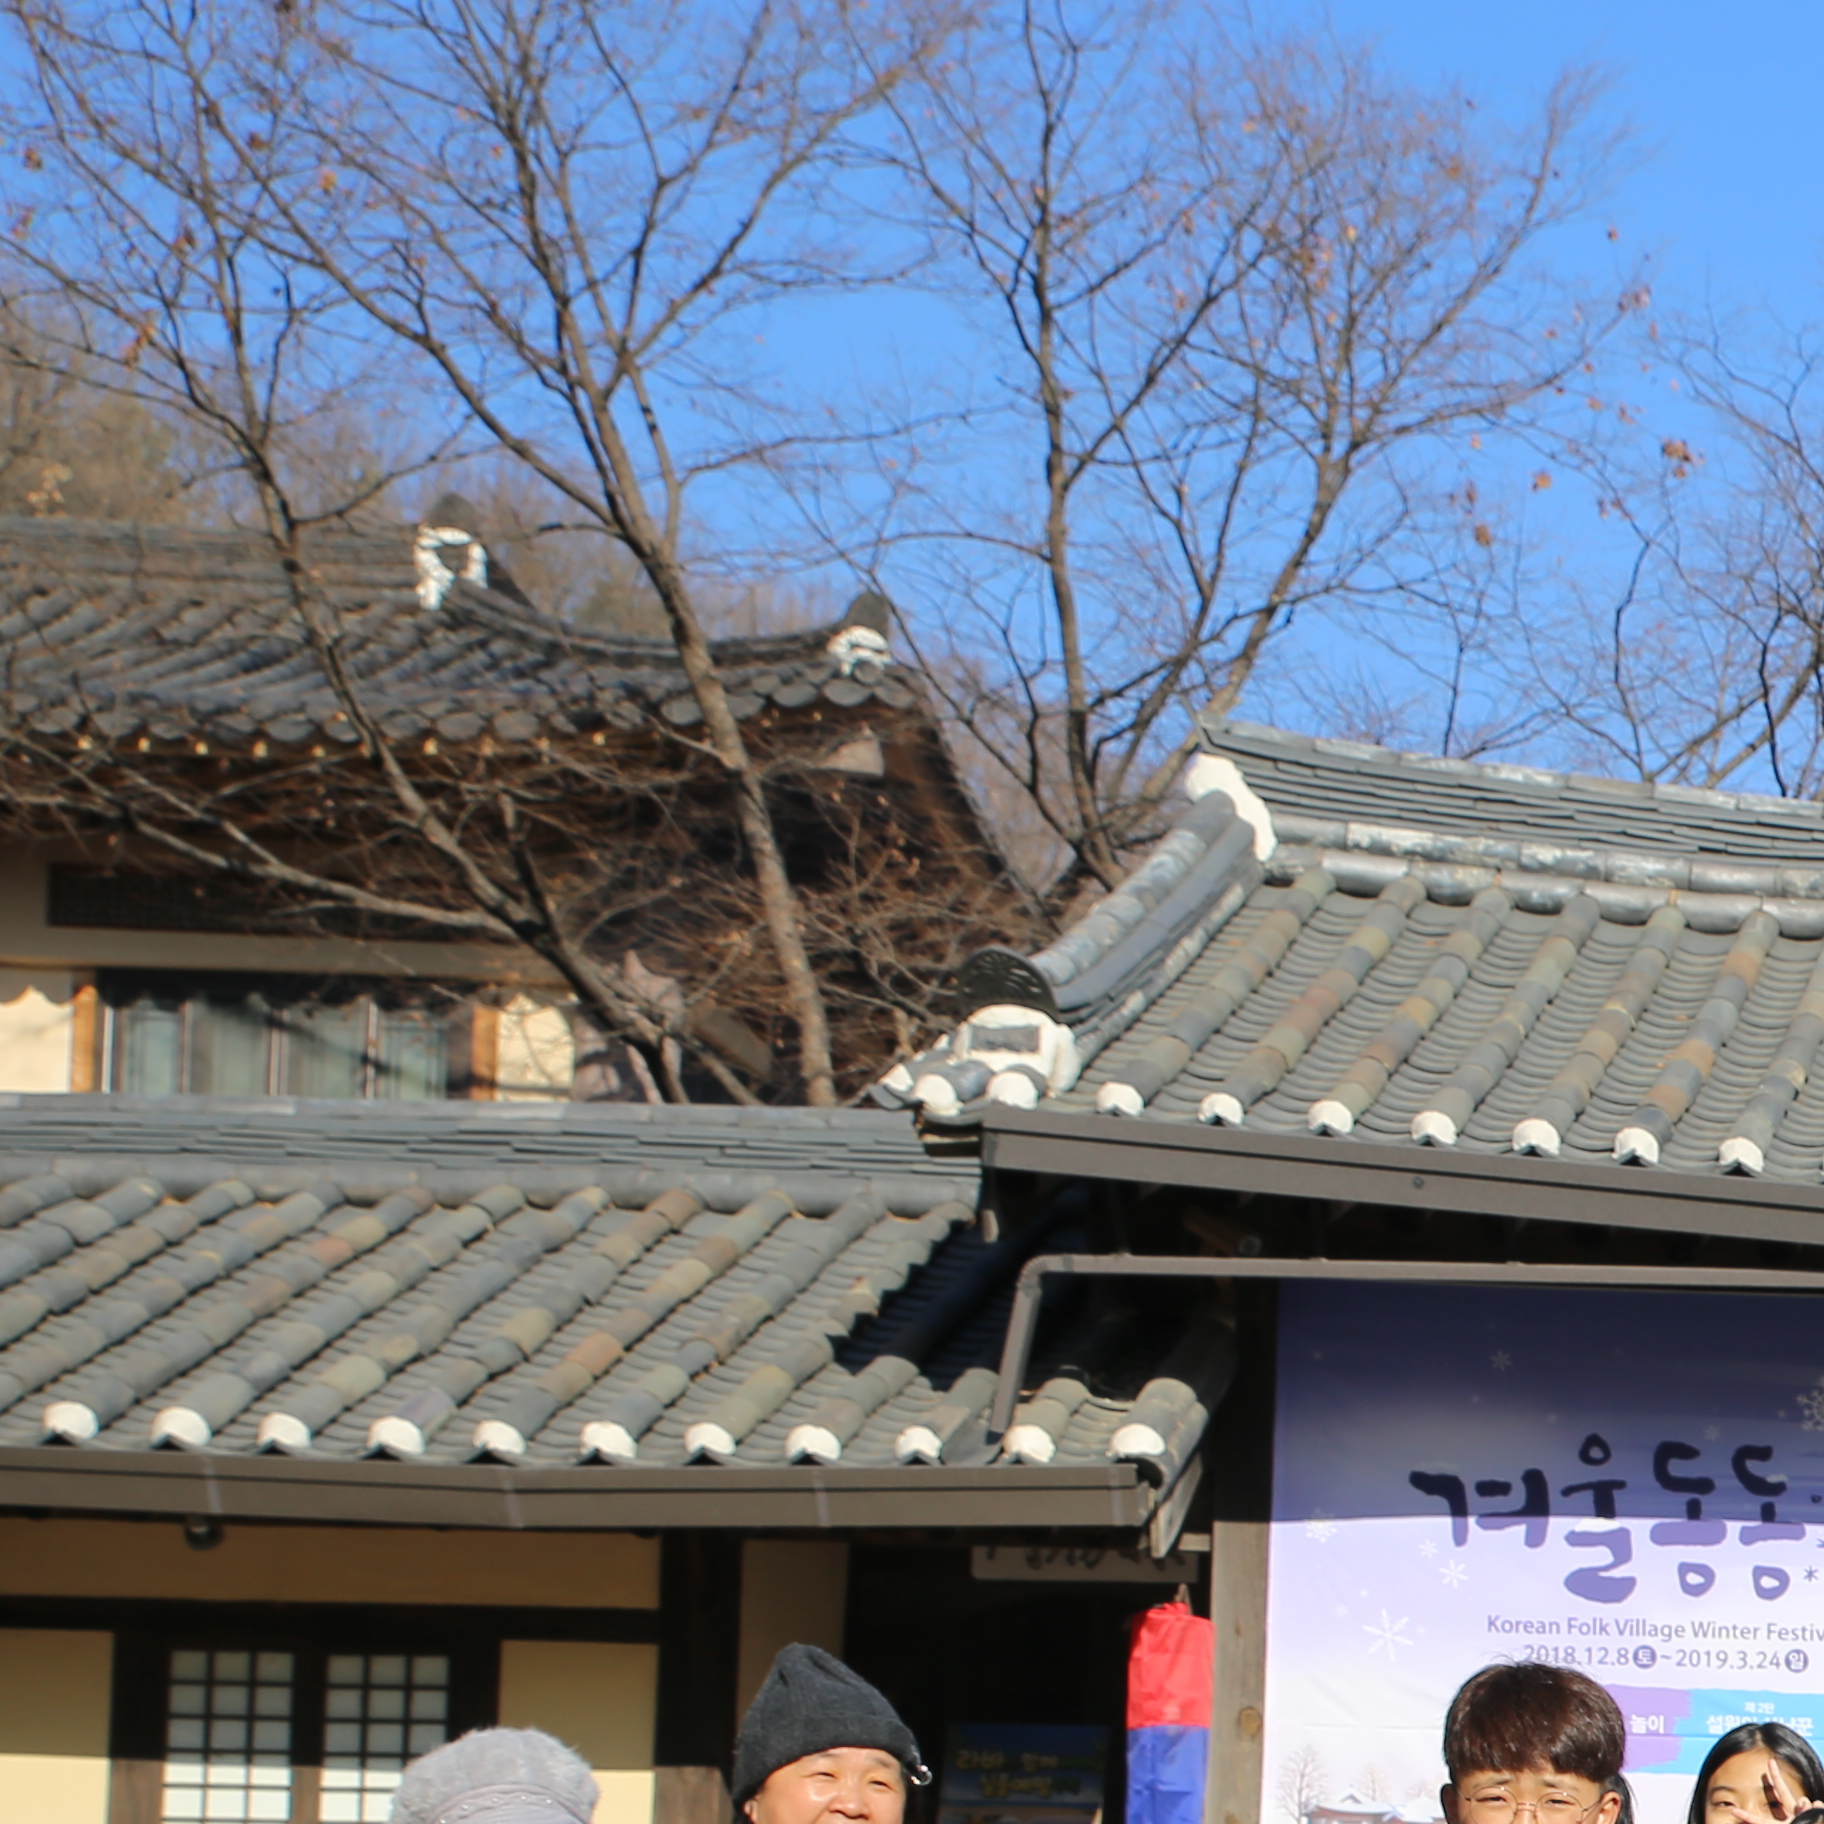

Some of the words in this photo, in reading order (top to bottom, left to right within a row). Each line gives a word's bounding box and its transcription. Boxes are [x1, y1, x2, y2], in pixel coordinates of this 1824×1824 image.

[1486, 1615, 1561, 1635] Korean
[1566, 1616, 1612, 1637] Folk
[1613, 1618, 1686, 1643] Village
[1690, 1620, 1761, 1641] Winter
[1630, 1715, 1665, 1734] 놀이
